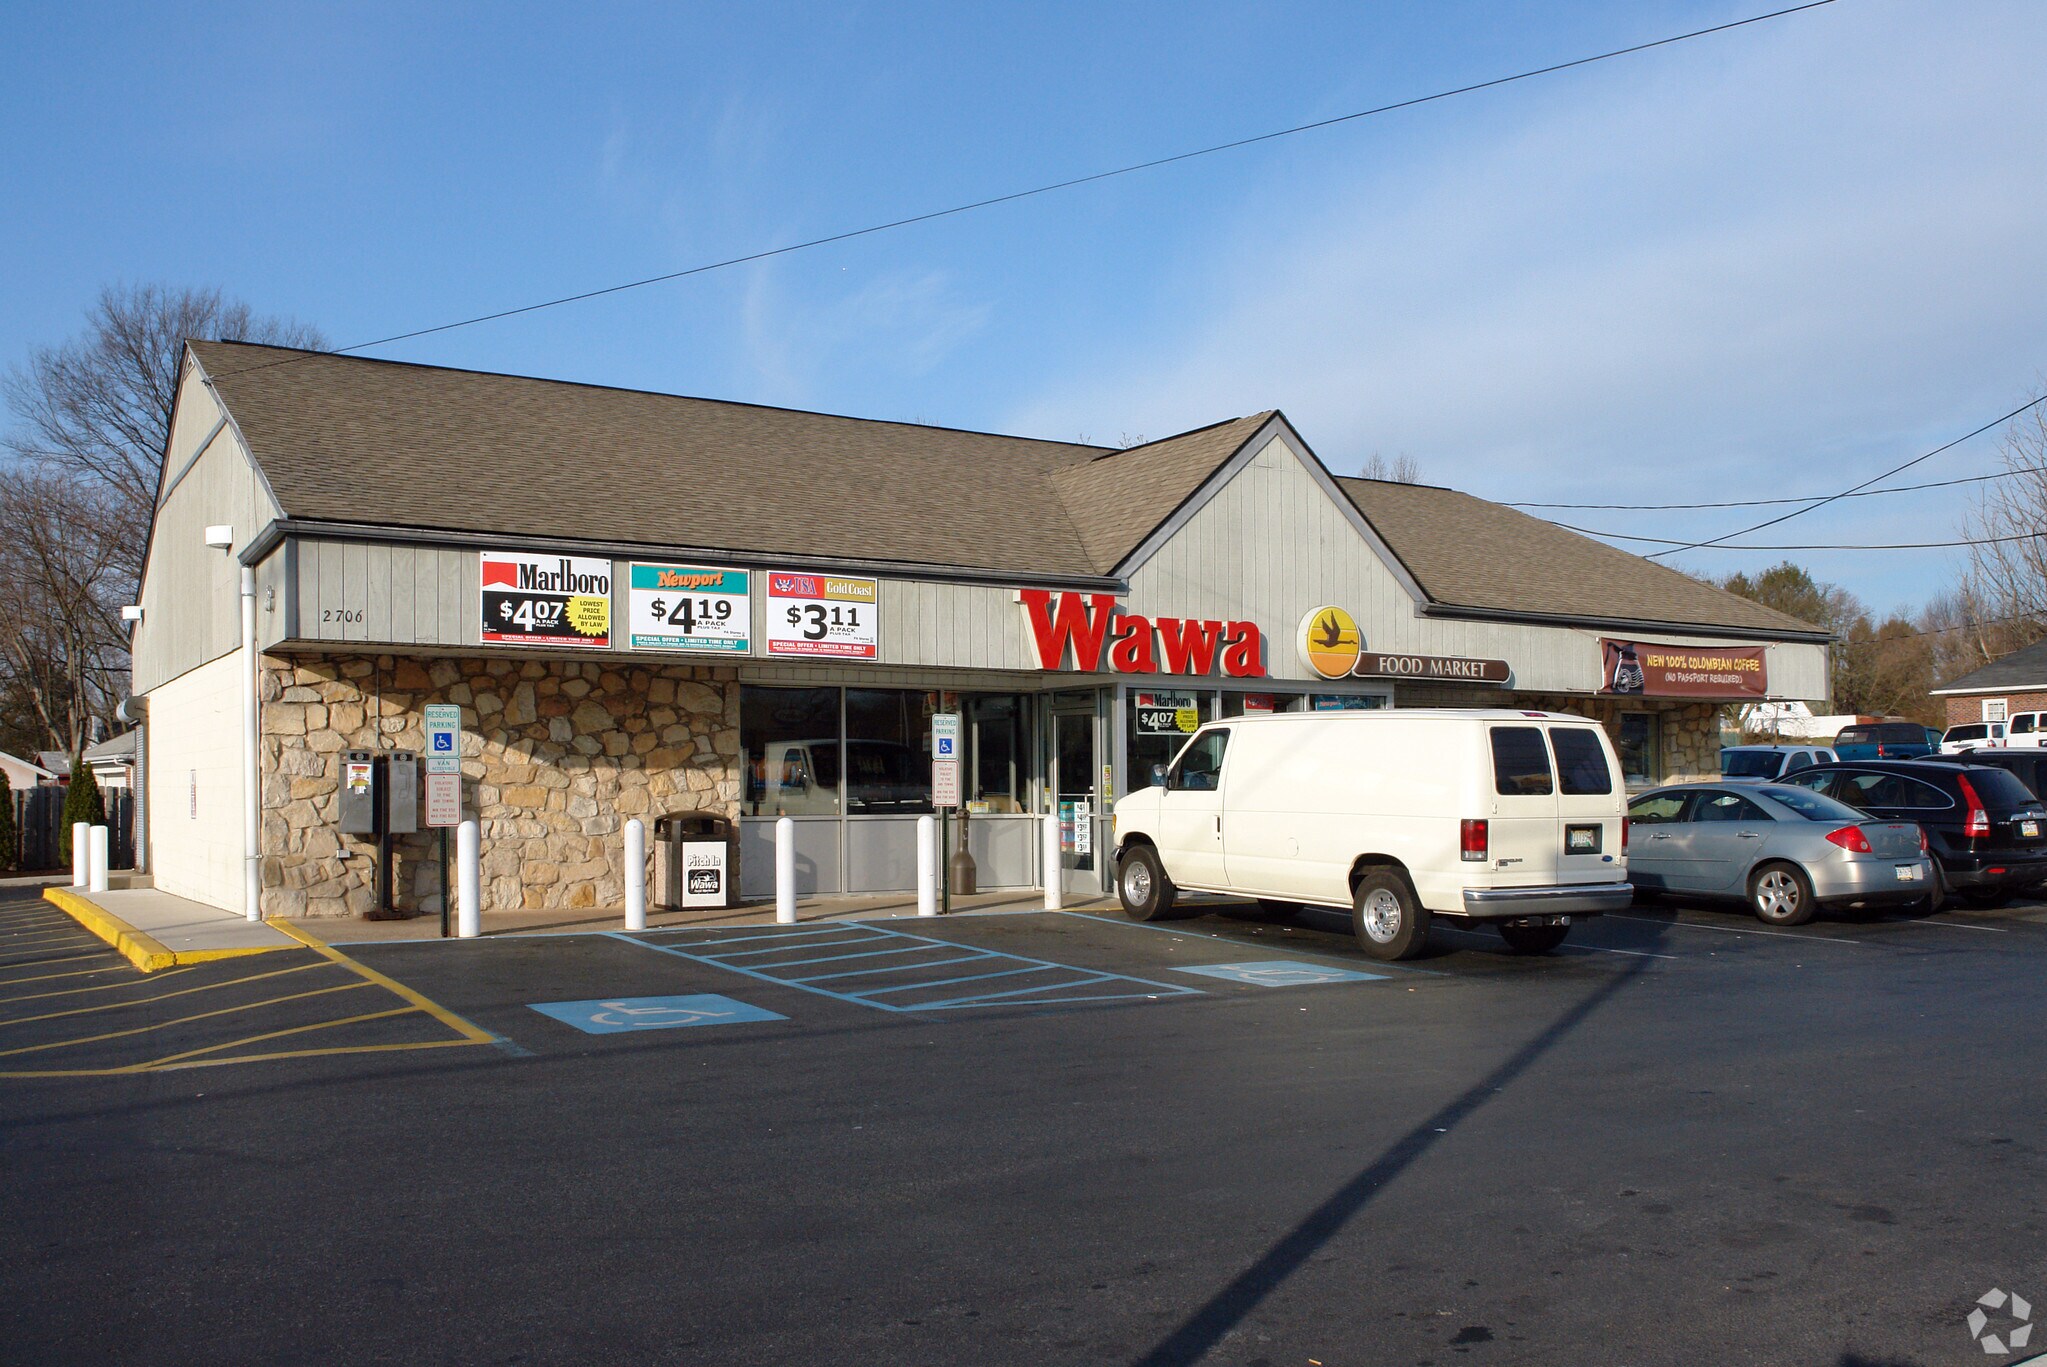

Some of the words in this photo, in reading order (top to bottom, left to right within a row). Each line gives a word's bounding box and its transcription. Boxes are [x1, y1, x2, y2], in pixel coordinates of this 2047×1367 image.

[519, 559, 609, 594] Marlboro
[657, 570, 724, 590] Newport
[794, 578, 817, 595] USA
[826, 582, 847, 594] Gold
[848, 583, 872, 596] Coast
[323, 610, 362, 622] 2706
[500, 600, 563, 632] $407
[651, 598, 732, 634] $419
[787, 604, 860, 640] $311
[1014, 589, 1266, 677] Wawa
[1379, 657, 1423, 674] FOOD
[1430, 660, 1486, 677] MARKET
[1647, 654, 1664, 667] NEW
[1666, 656, 1687, 669] 100%
[1688, 657, 1732, 670] COLOMBIAN
[1734, 658, 1760, 671] COFFEE
[1678, 672, 1708, 683] PASSPORT
[1710, 674, 1742, 684] REQUIRED)
[1155, 691, 1191, 707] Marlboro
[1142, 712, 1173, 730] $407
[688, 854, 710, 867] Pitch
[712, 855, 721, 866] In
[691, 879, 718, 889] Wawa
